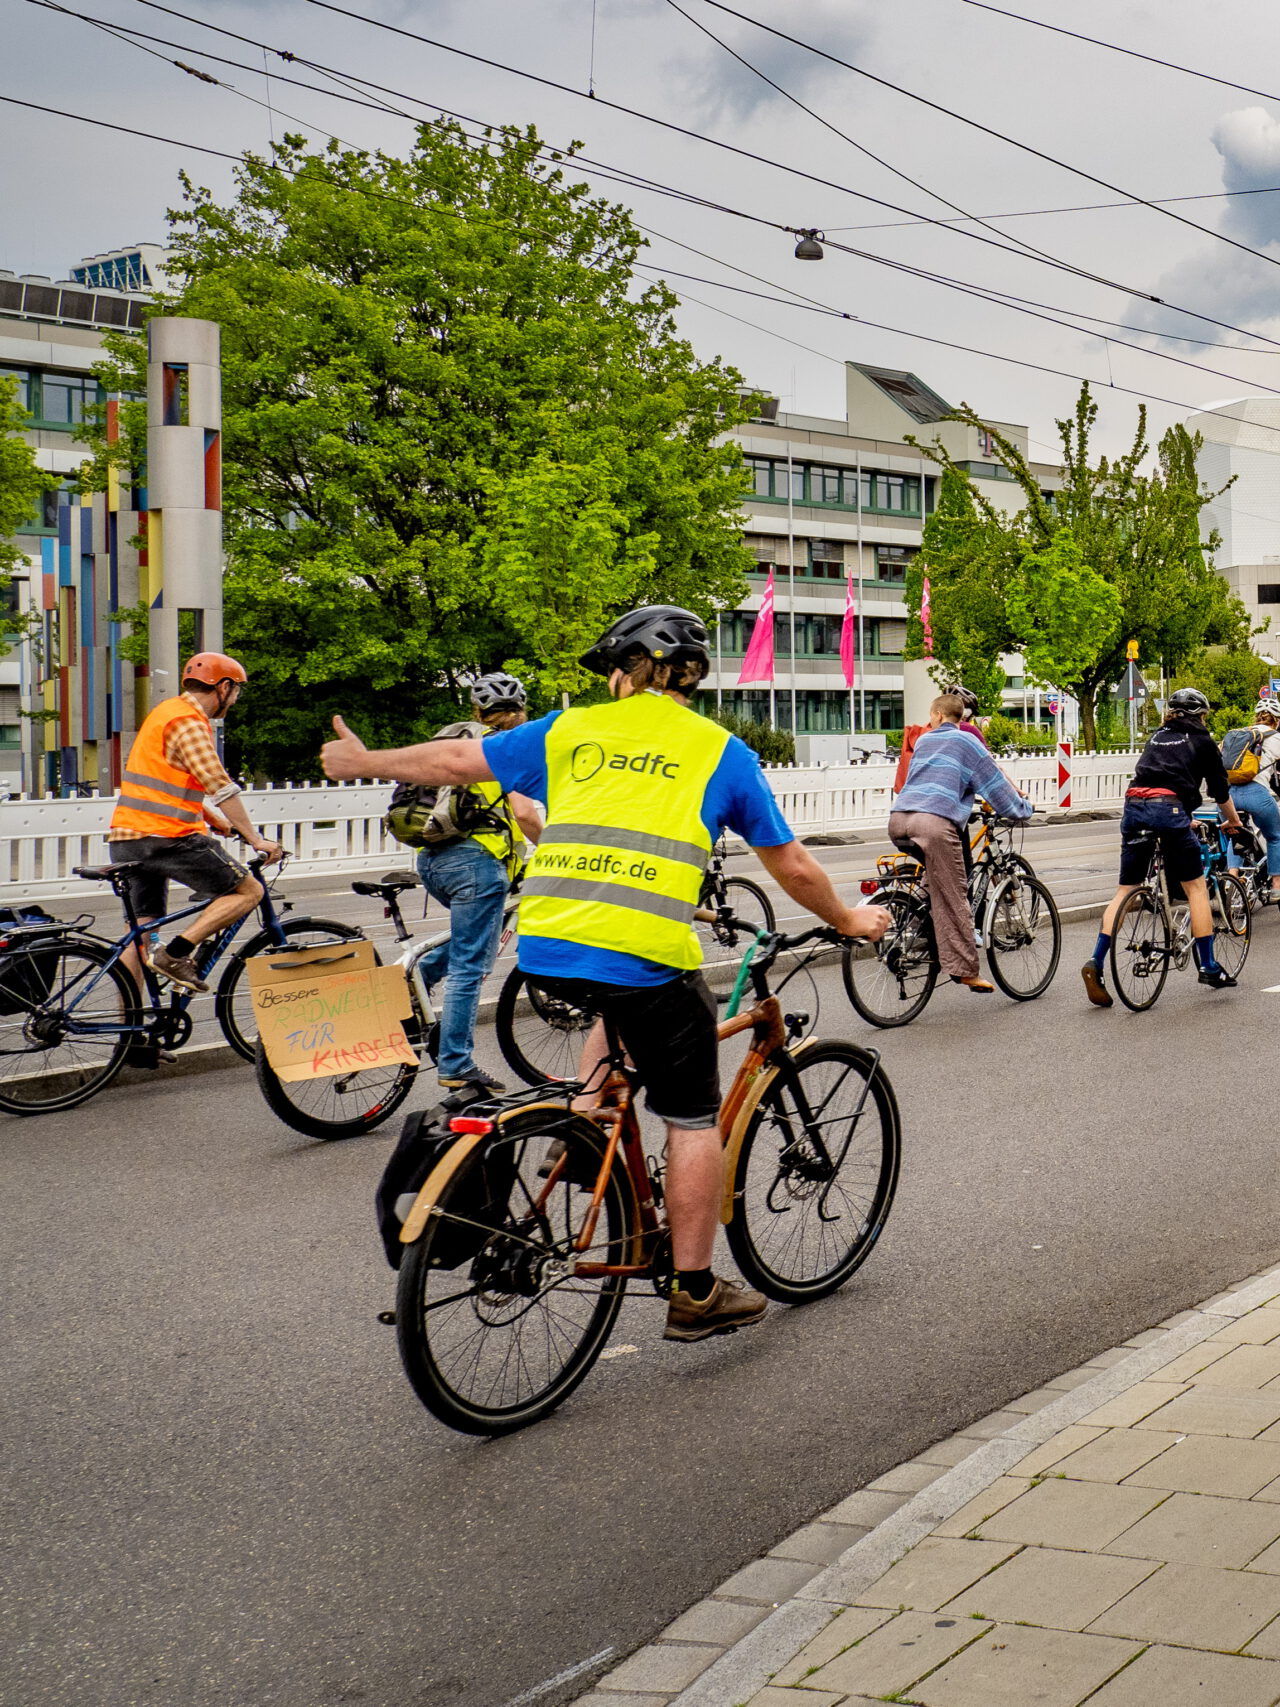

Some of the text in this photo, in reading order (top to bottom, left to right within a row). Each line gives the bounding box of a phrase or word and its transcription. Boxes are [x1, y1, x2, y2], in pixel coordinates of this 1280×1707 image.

[608, 752, 680, 779] adfc
[534, 854, 657, 881] www.adfc.de
[257, 988, 320, 1009] Bessere
[271, 982, 386, 1032] RADWEGE
[284, 1022, 335, 1054] FÜR
[312, 1032, 412, 1073] KINDER
